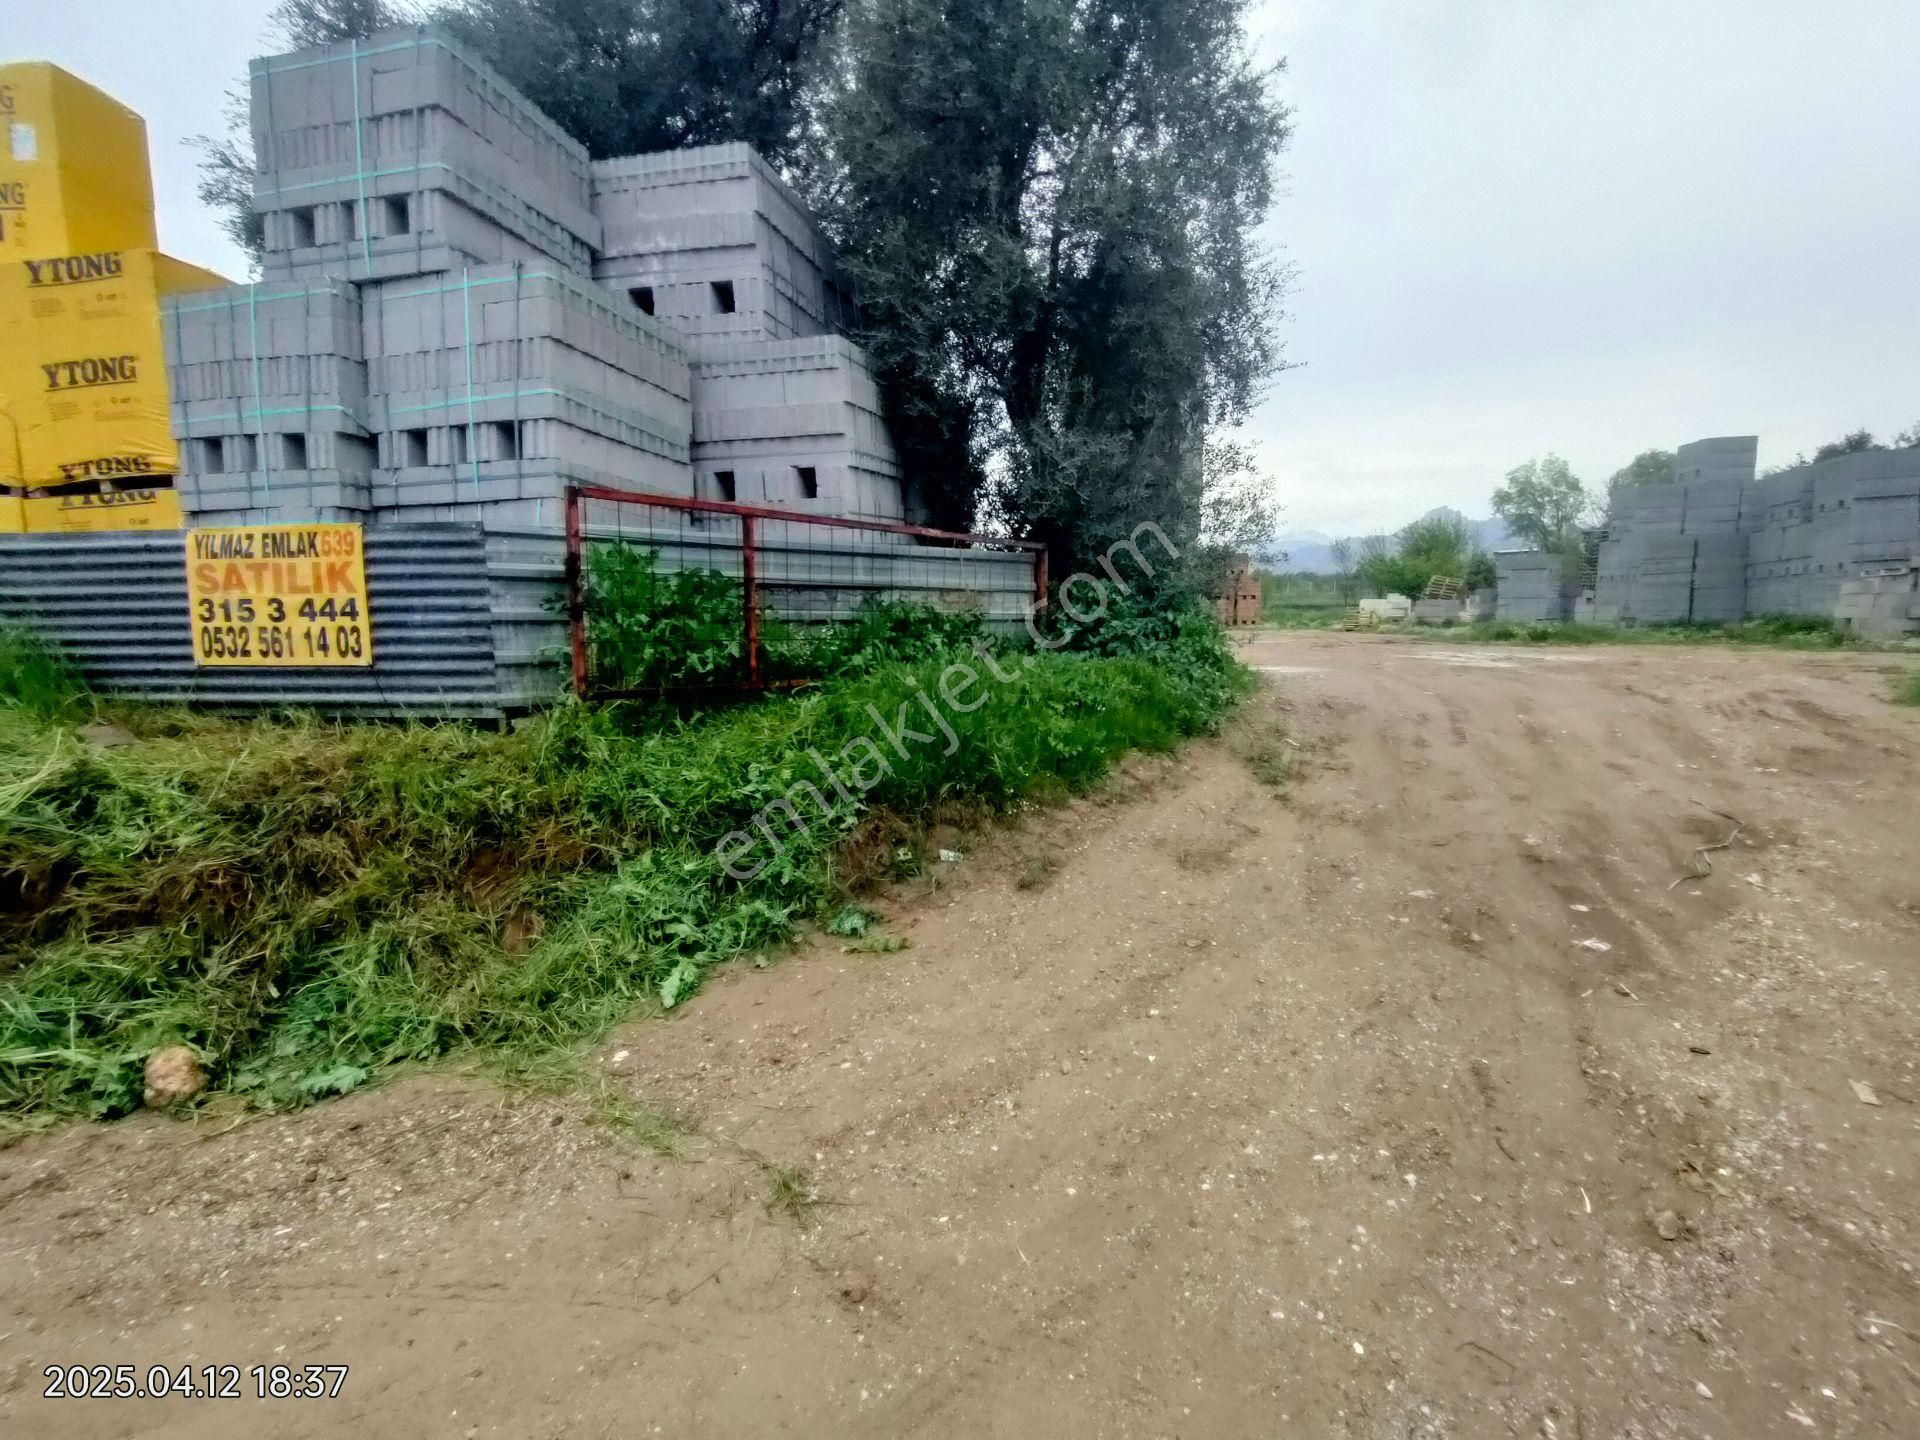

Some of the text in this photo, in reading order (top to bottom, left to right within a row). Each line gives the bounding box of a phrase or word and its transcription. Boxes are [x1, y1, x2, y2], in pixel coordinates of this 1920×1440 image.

[23, 252, 123, 284] YTONG
[40, 355, 137, 388] YTONG
[195, 530, 355, 559] YILMAZ EMLAK 639
[195, 561, 357, 595] SATILIK
[198, 597, 360, 623] 315 3 444
[201, 625, 362, 659] 0532 561 14 03
